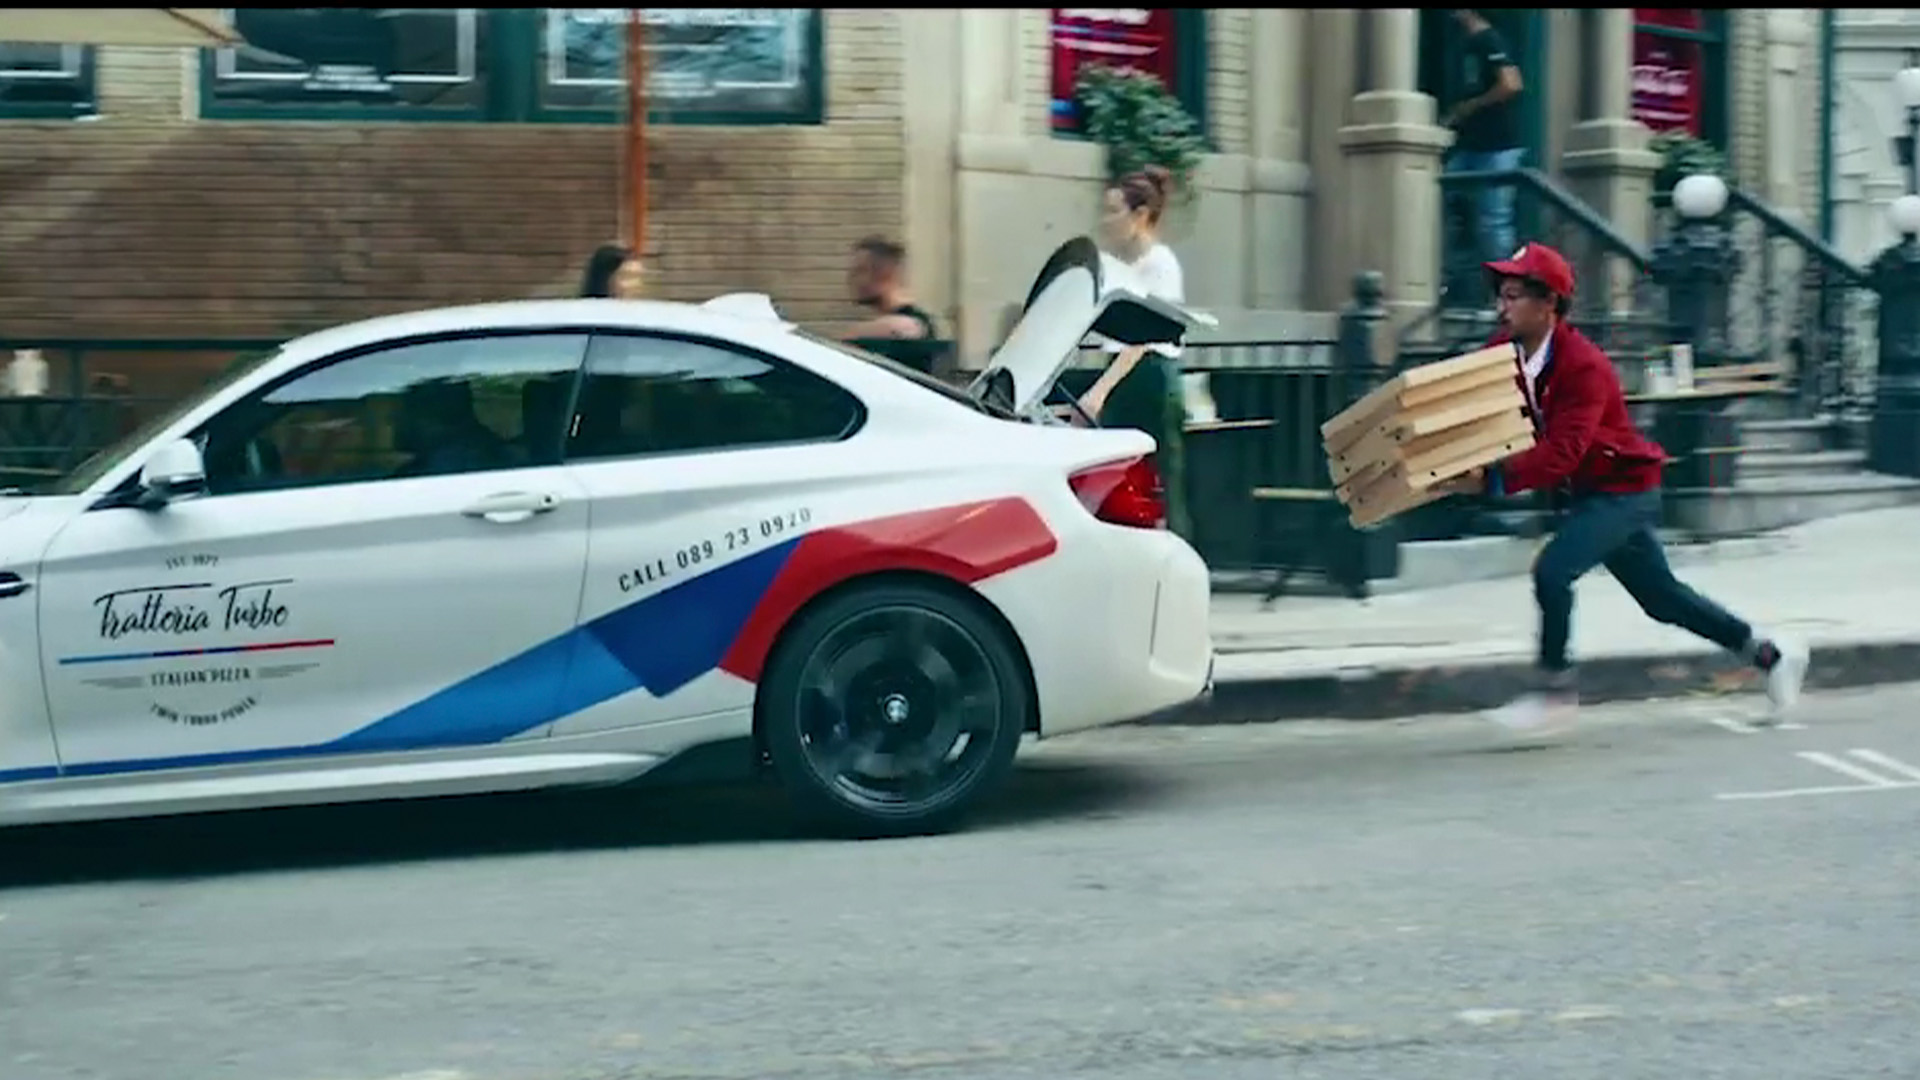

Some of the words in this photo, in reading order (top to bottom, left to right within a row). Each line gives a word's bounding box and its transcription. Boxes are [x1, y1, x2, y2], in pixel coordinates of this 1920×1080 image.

[619, 557, 669, 592] CALL
[676, 539, 714, 569] 089
[93, 582, 212, 640] Trattoria
[218, 577, 294, 631] Turbo
[151, 670, 206, 686] ITALIAN
[210, 666, 251, 683] PIZZA
